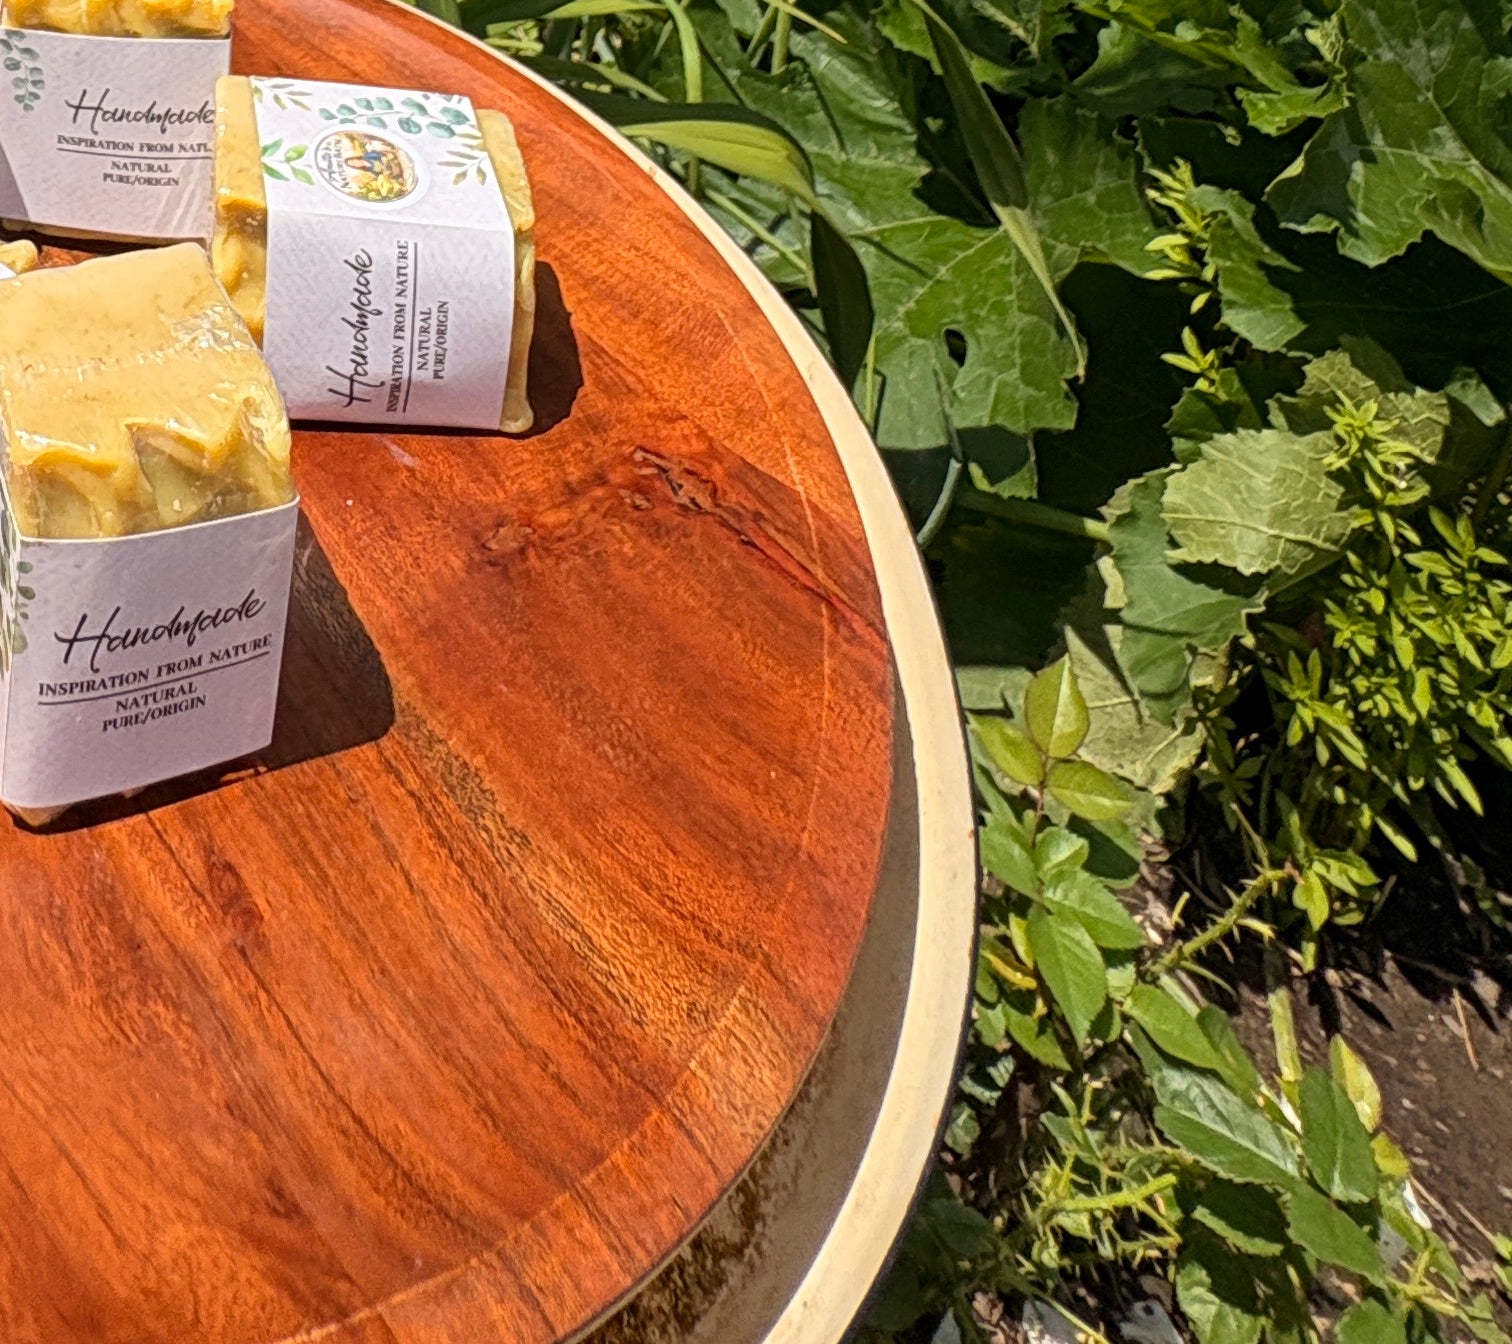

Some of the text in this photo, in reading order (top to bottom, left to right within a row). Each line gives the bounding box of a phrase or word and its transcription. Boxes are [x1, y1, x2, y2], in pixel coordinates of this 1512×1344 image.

[64, 88, 216, 135] Handmade
[57, 135, 212, 153] INSPIRATION FROM NATU
[111, 161, 172, 173] NATURAL
[103, 173, 179, 186] PURE/ORIGIN
[325, 248, 385, 408] Handmade
[386, 240, 408, 412] INSPIRATION FROM NATURE
[417, 307, 432, 371] NATURAL
[433, 300, 449, 379] PURE/ORIGIN
[54, 588, 266, 673] Handmade
[38, 633, 272, 696] INSPIRATION FROM NATURE
[102, 695, 206, 732] PURE/ORIGIN
[116, 681, 198, 713] NATURAL
